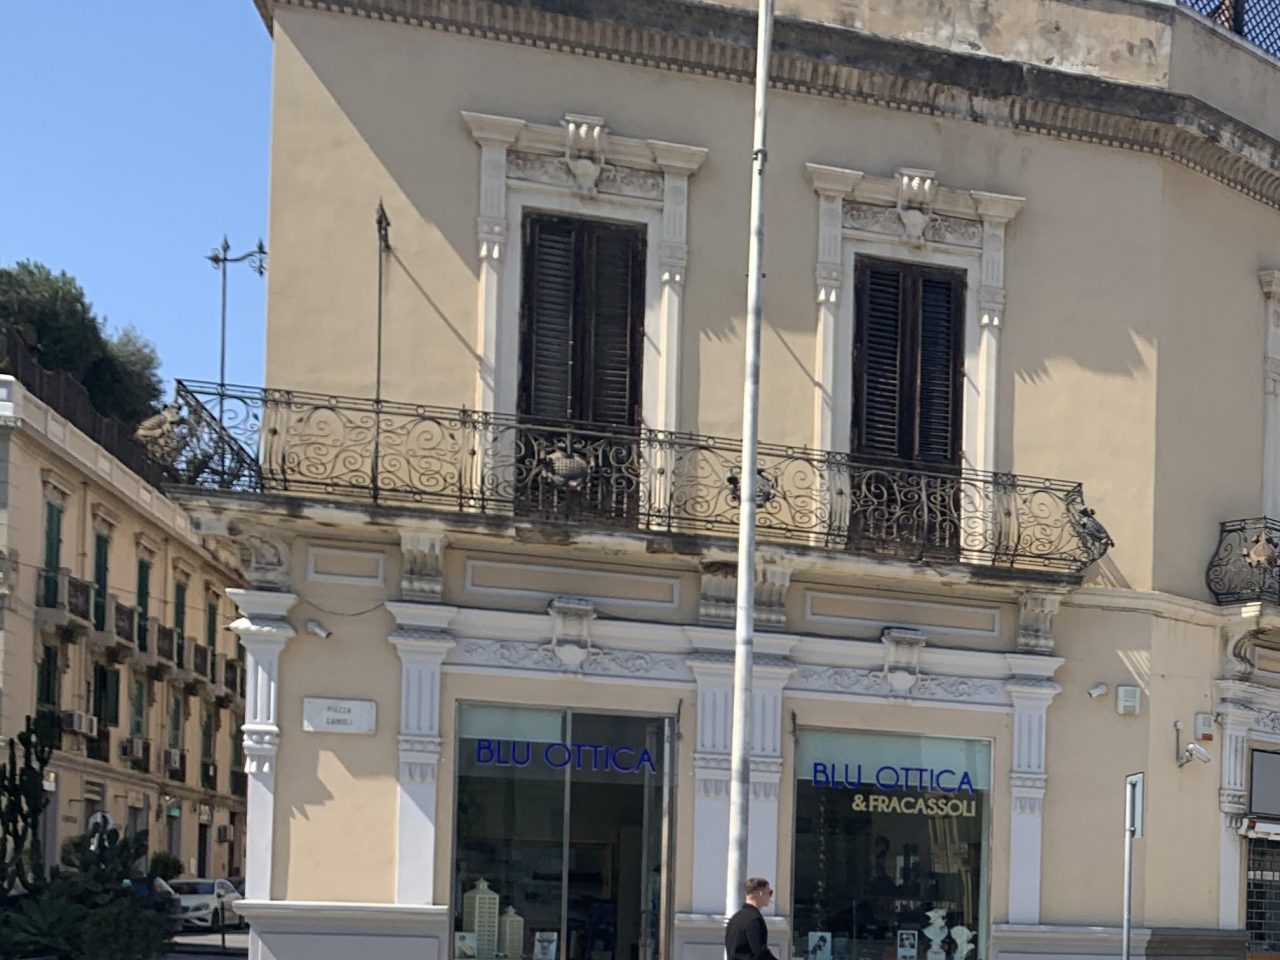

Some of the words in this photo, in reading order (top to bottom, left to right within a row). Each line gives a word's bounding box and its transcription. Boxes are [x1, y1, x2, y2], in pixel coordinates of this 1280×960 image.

[476, 738, 531, 767] BLU
[544, 742, 657, 775] OTTICA
[811, 762, 862, 790] BLU
[875, 765, 976, 796] OTTICA
[868, 795, 977, 818] FRACASSOLI
